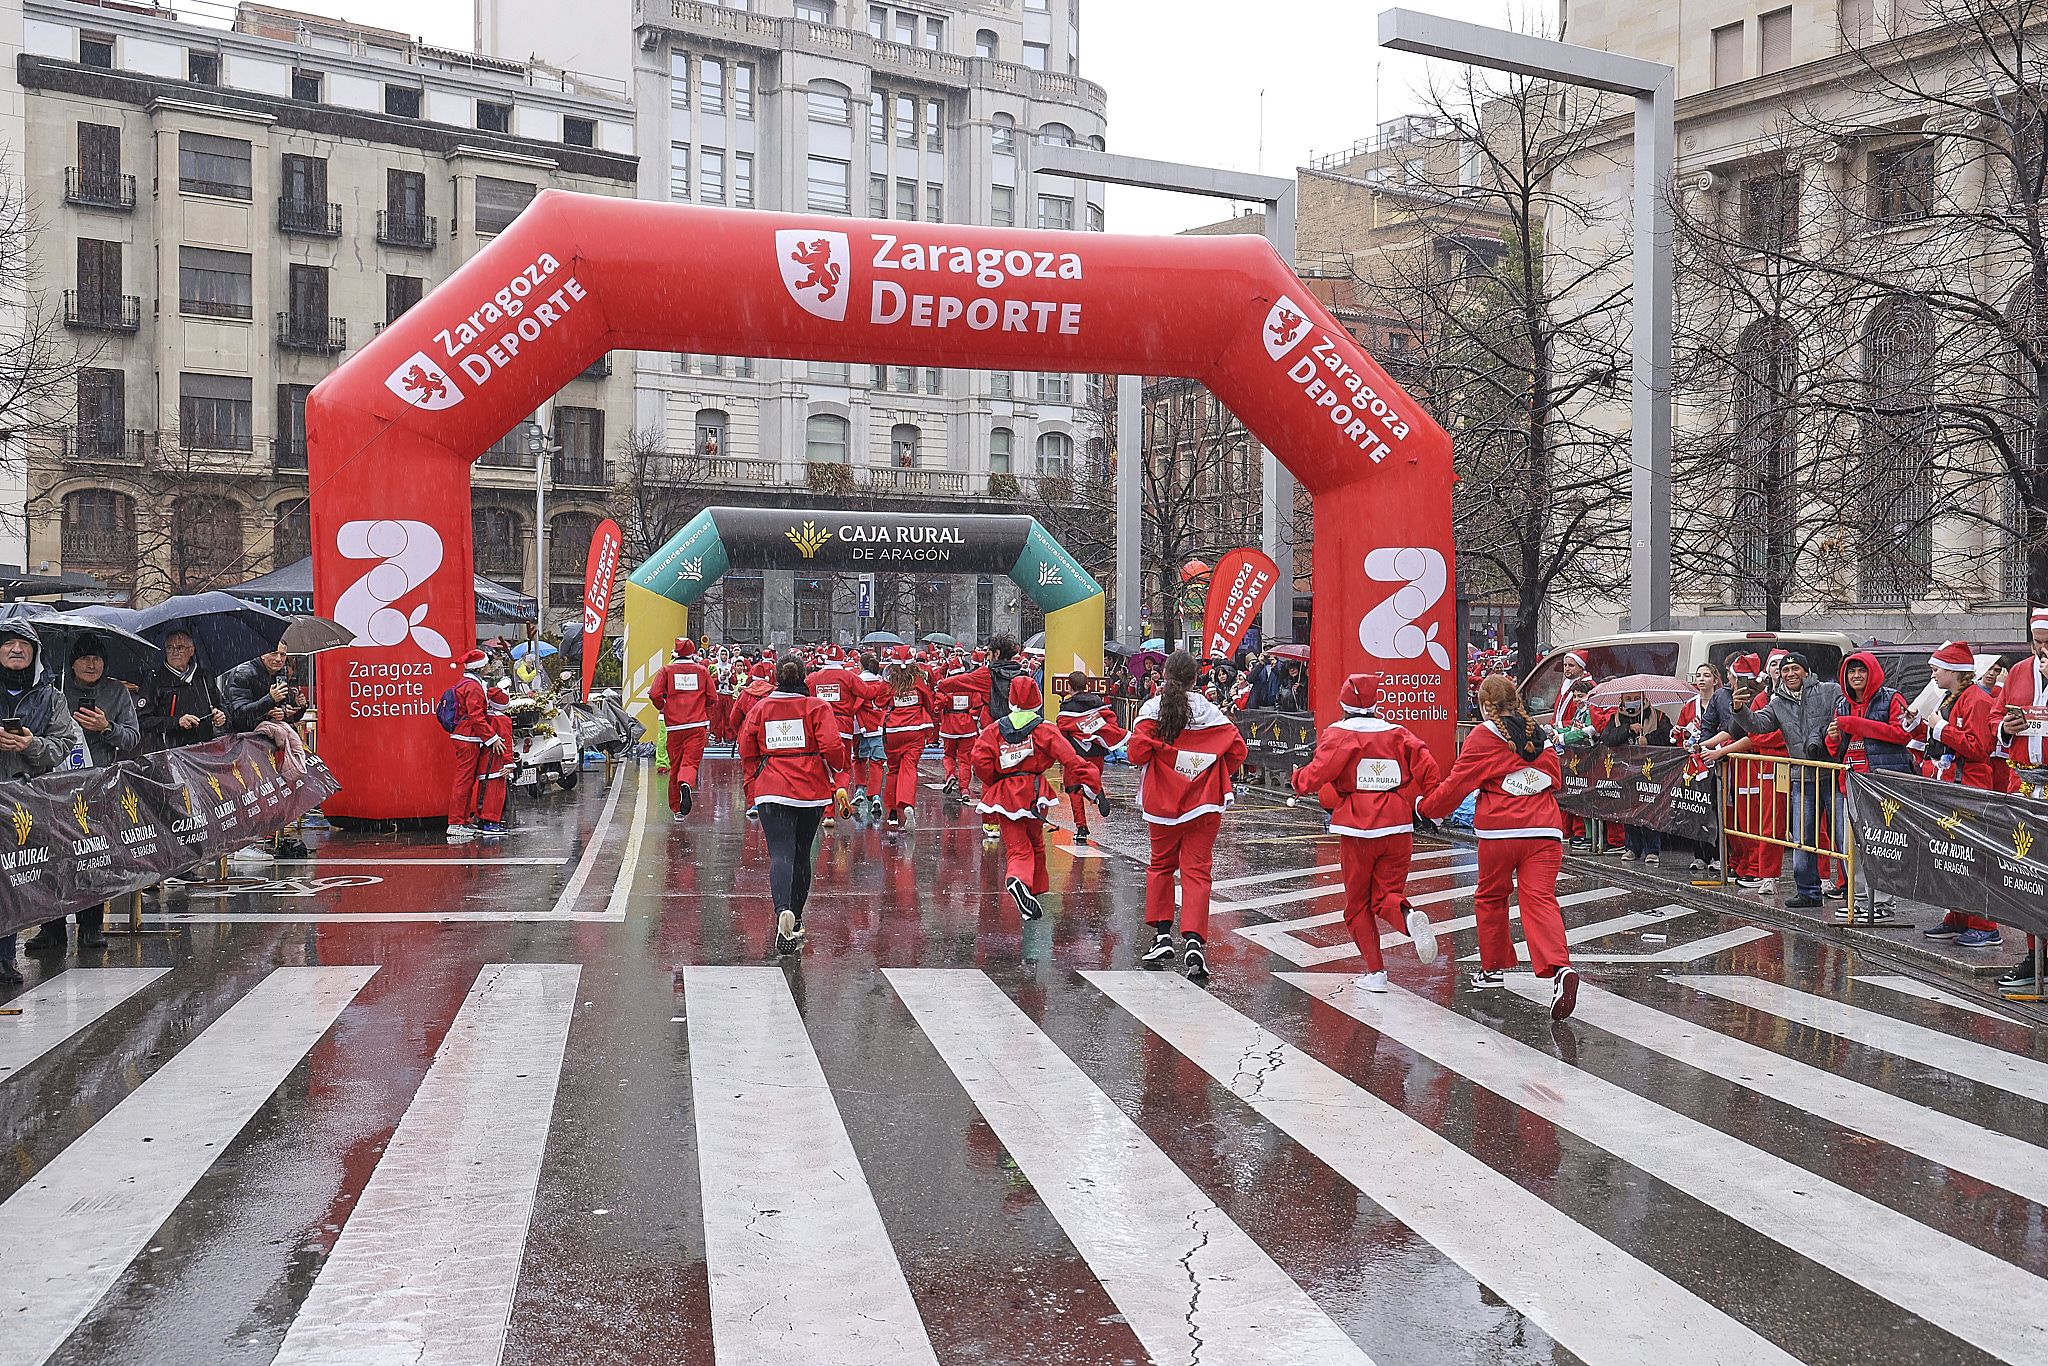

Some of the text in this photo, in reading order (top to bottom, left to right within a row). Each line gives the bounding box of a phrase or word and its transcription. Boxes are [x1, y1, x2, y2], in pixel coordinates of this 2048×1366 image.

[870, 233, 1084, 289] Zaragoza
[432, 252, 561, 358] Zaragoza
[870, 280, 1083, 335] DEPORTE
[458, 277, 588, 386] DEPORTE
[1311, 335, 1411, 441] Zaragoza
[1286, 355, 1392, 464] DEPORTE
[838, 525, 966, 544] CAJA RURAL
[643, 521, 712, 585] cajaruraldearagon.es
[852, 546, 950, 561] DE ARAGÓN
[588, 533, 611, 604] Zaragoza
[595, 539, 618, 611] DEPORTE
[1218, 562, 1254, 630] Zaragoza
[1225, 570, 1269, 637] DEPORTE
[349, 661, 433, 681] Zaragoza
[1375, 671, 1441, 689] Zaragoza
[350, 680, 423, 701] Deporte
[1376, 689, 1436, 707] Deporte
[1375, 704, 1448, 720] Sostenible
[1506, 778, 1524, 790] CAJA
[1684, 788, 1712, 805] RURAL
[1677, 801, 1707, 815] ARAGÓN
[171, 818, 193, 833] CAJA
[1882, 830, 1909, 848] RURAL
[17, 845, 50, 867] RURAL
[1870, 845, 1903, 861] ARAGÓN
[1948, 841, 1976, 863] RURAL
[1934, 858, 1970, 877] DE ARAGÓN
[2003, 874, 2044, 897] DE ARAGÓN
